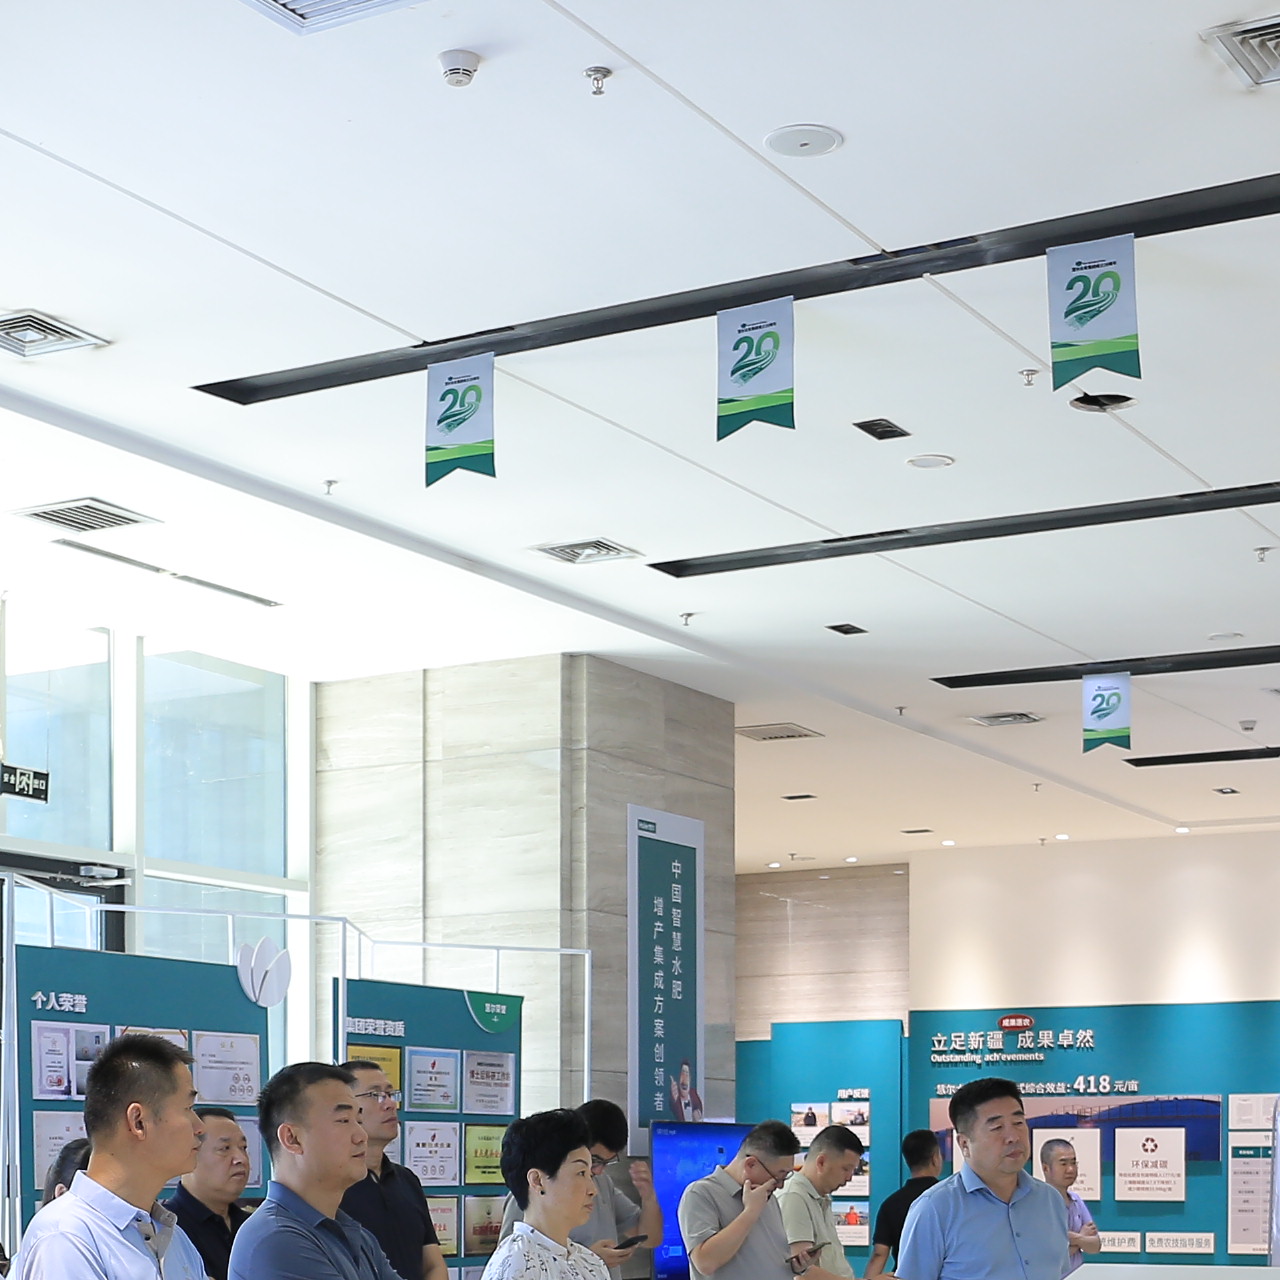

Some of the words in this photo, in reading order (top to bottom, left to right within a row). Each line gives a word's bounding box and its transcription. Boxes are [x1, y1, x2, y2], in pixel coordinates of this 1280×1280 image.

[1064, 271, 1121, 320] 20
[730, 331, 780, 379] 20
[437, 385, 482, 427] 20
[1090, 692, 1122, 719] 20
[671, 859, 683, 1000] 中国智慧水肥
[30, 990, 88, 1013] 个人荣誉
[653, 896, 665, 1111] 增产集成方案创领者
[346, 1016, 406, 1037] 集团荣誉资质
[931, 1030, 1004, 1051] 立足新疆
[1017, 1029, 1095, 1048] 成果卓然
[931, 1053, 982, 1064] Outstanding
[837, 1088, 869, 1099] 用户反馈
[1073, 1075, 1111, 1093] 418
[1114, 1080, 1139, 1093] 元/亩
[1131, 1160, 1168, 1169] 环保减碳
[1148, 1237, 1211, 1249] 免费农技指导服务
